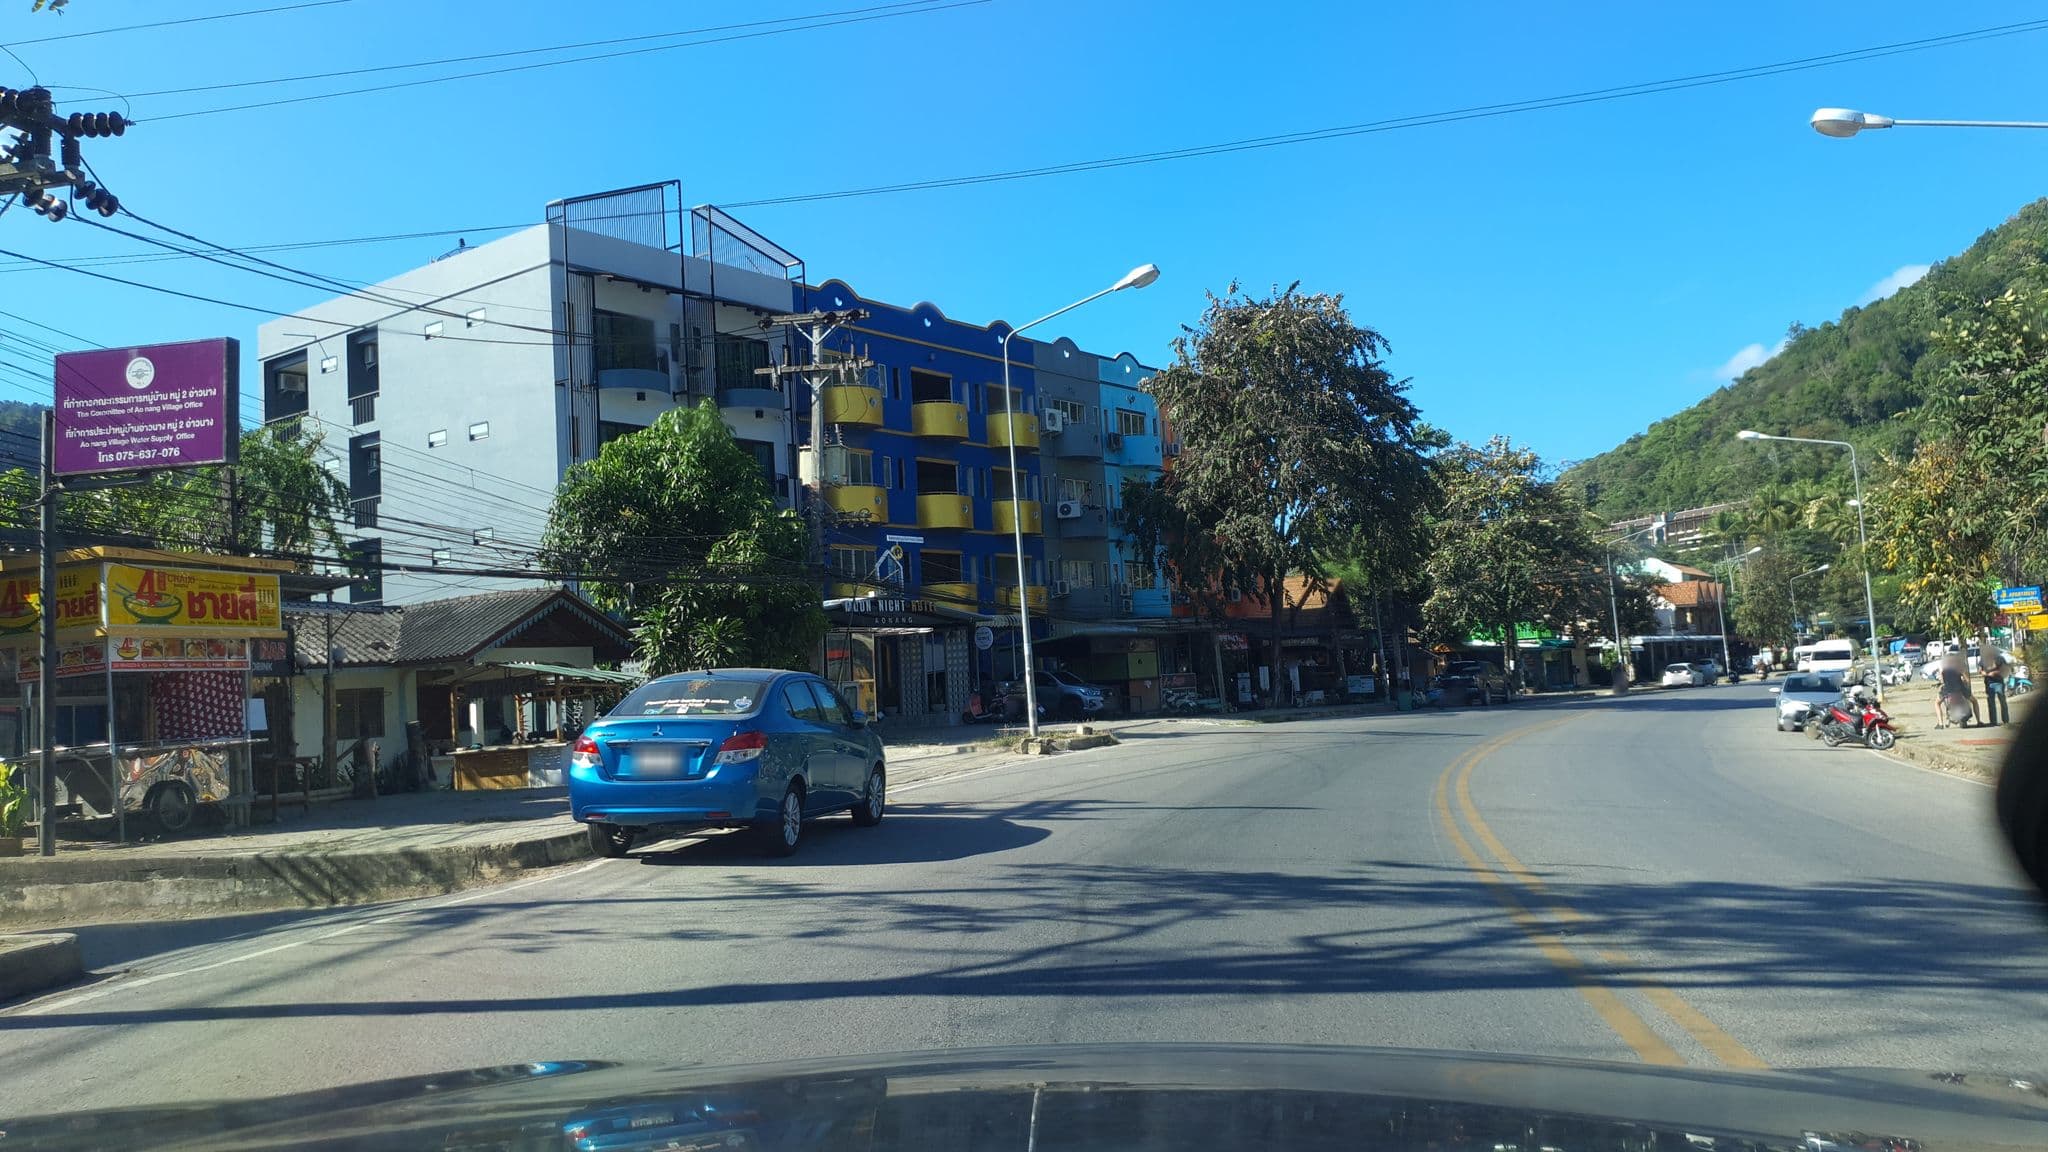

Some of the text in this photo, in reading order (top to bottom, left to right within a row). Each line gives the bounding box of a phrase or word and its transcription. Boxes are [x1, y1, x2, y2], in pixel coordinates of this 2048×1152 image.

[182, 390, 187, 399] 2
[189, 386, 217, 398] อ่าวนาง
[90, 408, 126, 417] Committee
[144, 405, 161, 413] nang
[161, 402, 183, 411] Village
[184, 401, 203, 409] Office
[179, 420, 184, 429] 2
[186, 417, 214, 428] อ่าวนาง
[108, 438, 129, 446] Village
[130, 436, 149, 444] Water
[150, 434, 173, 443] Supply
[98, 447, 180, 463] โทร 075-637-076
[187, 575, 257, 621] ชายสี่
[878, 600, 906, 612] NIGHT
